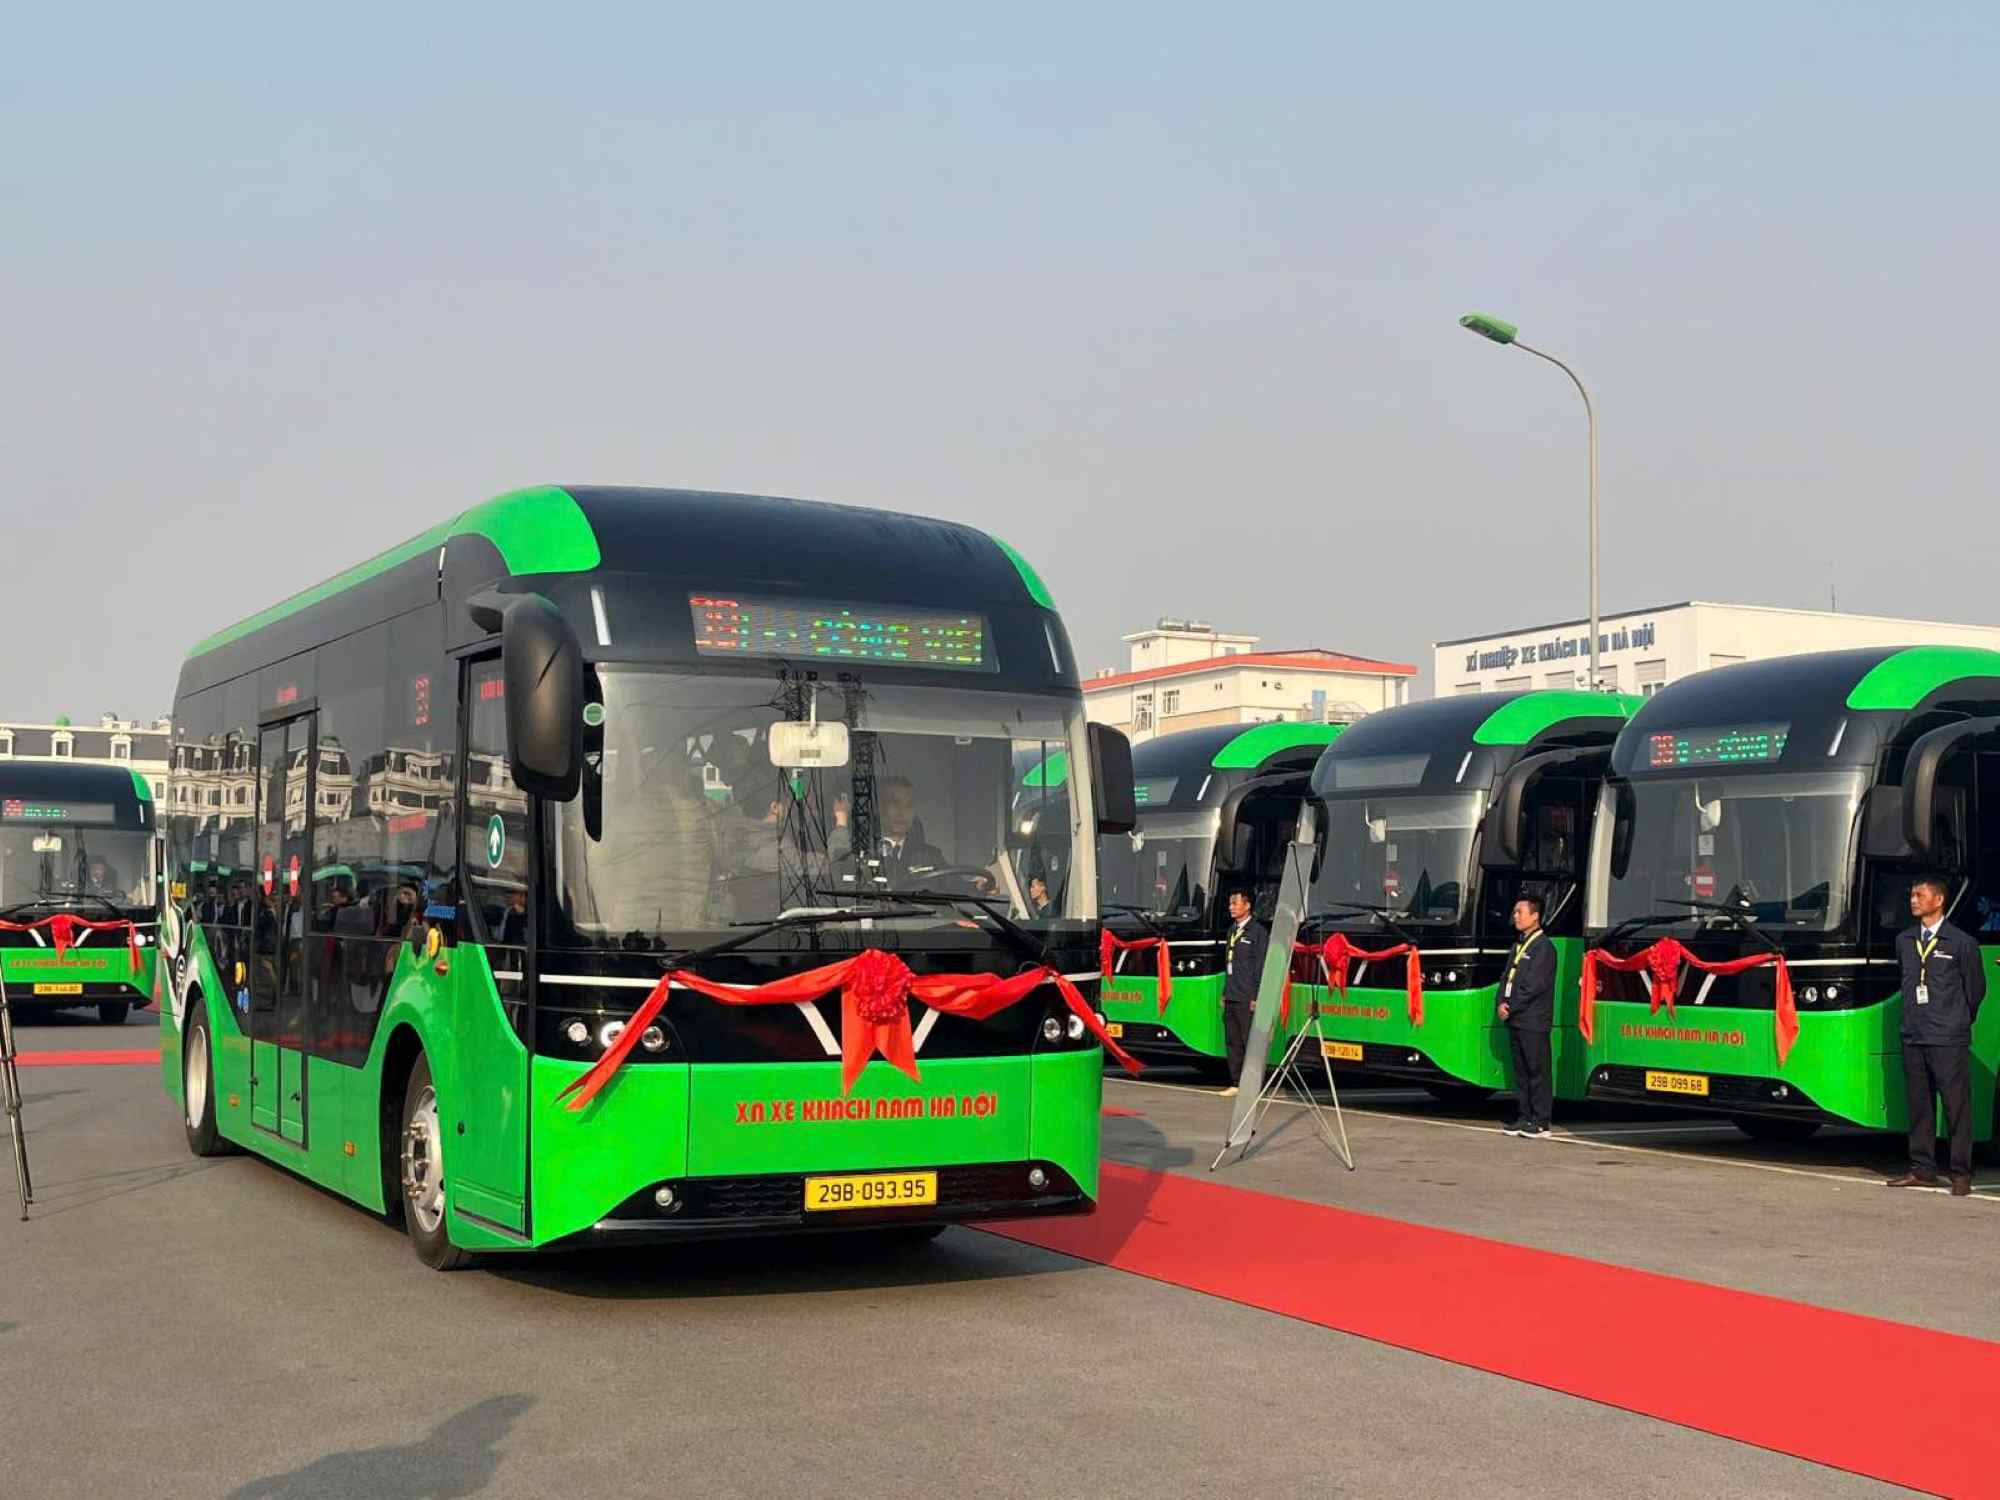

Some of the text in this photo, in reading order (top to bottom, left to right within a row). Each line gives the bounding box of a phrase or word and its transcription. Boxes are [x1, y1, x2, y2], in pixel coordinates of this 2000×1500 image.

[1520, 645, 1536, 664] XE
[1538, 637, 1577, 662] KHÁCH
[1580, 632, 1609, 656] NM
[770, 1101, 795, 1121] XE
[818, 1179, 927, 1203] 29B-093.95
